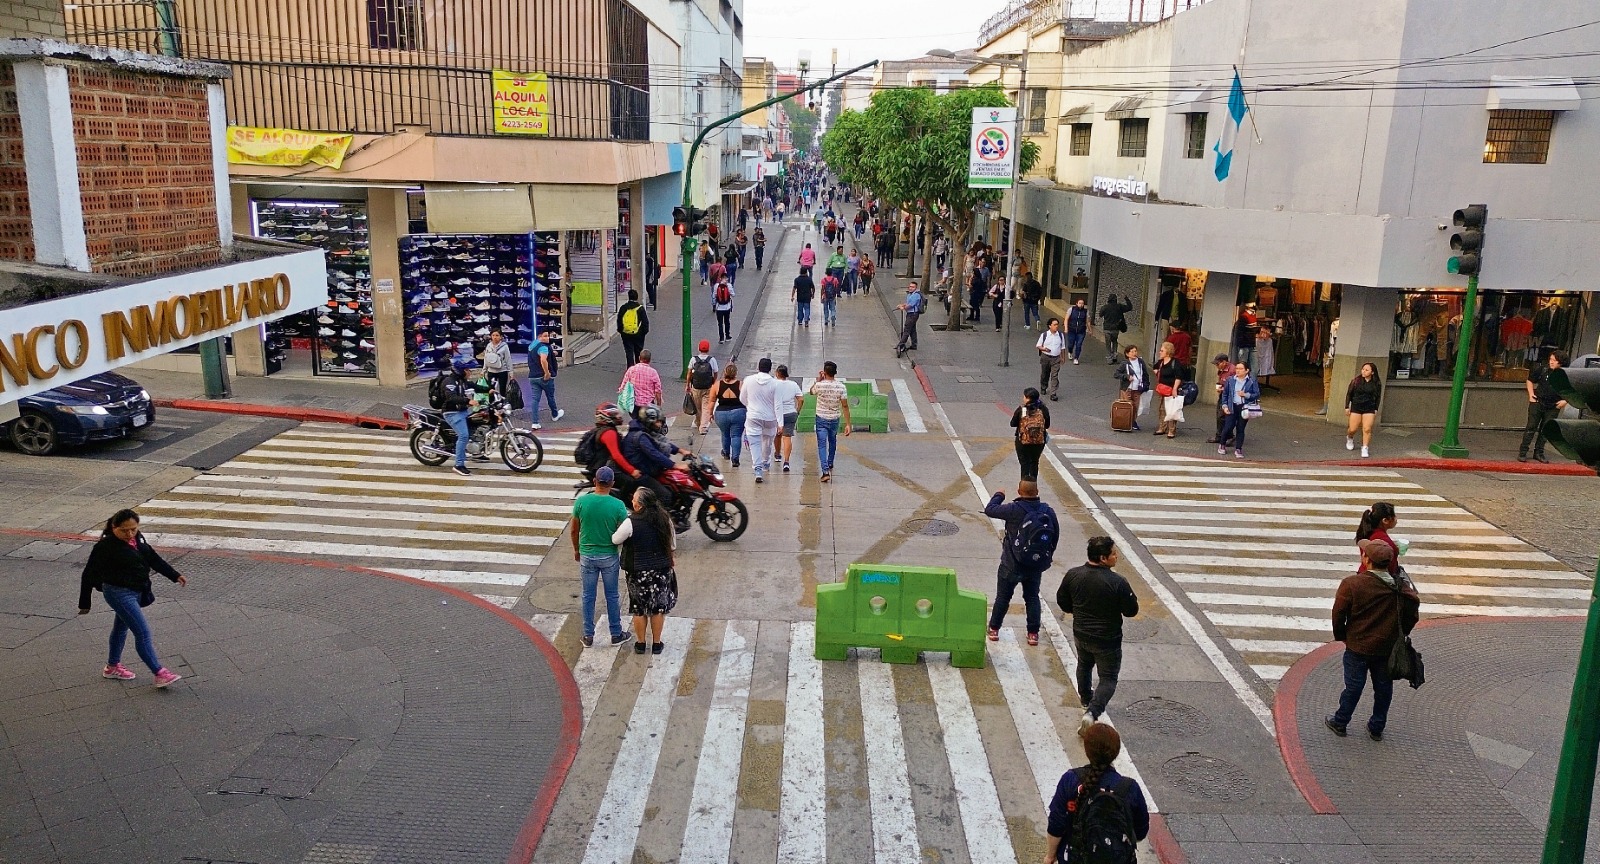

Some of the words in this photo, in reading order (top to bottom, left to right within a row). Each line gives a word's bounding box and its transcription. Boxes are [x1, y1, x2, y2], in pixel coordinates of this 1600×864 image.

[513, 76, 527, 86] SE
[495, 91, 547, 103] ALQUILA
[502, 106, 541, 117] LOCAL
[502, 121, 543, 129] 4223-2549
[235, 129, 256, 142] SE
[102, 273, 291, 361] INMOBILIARIO
